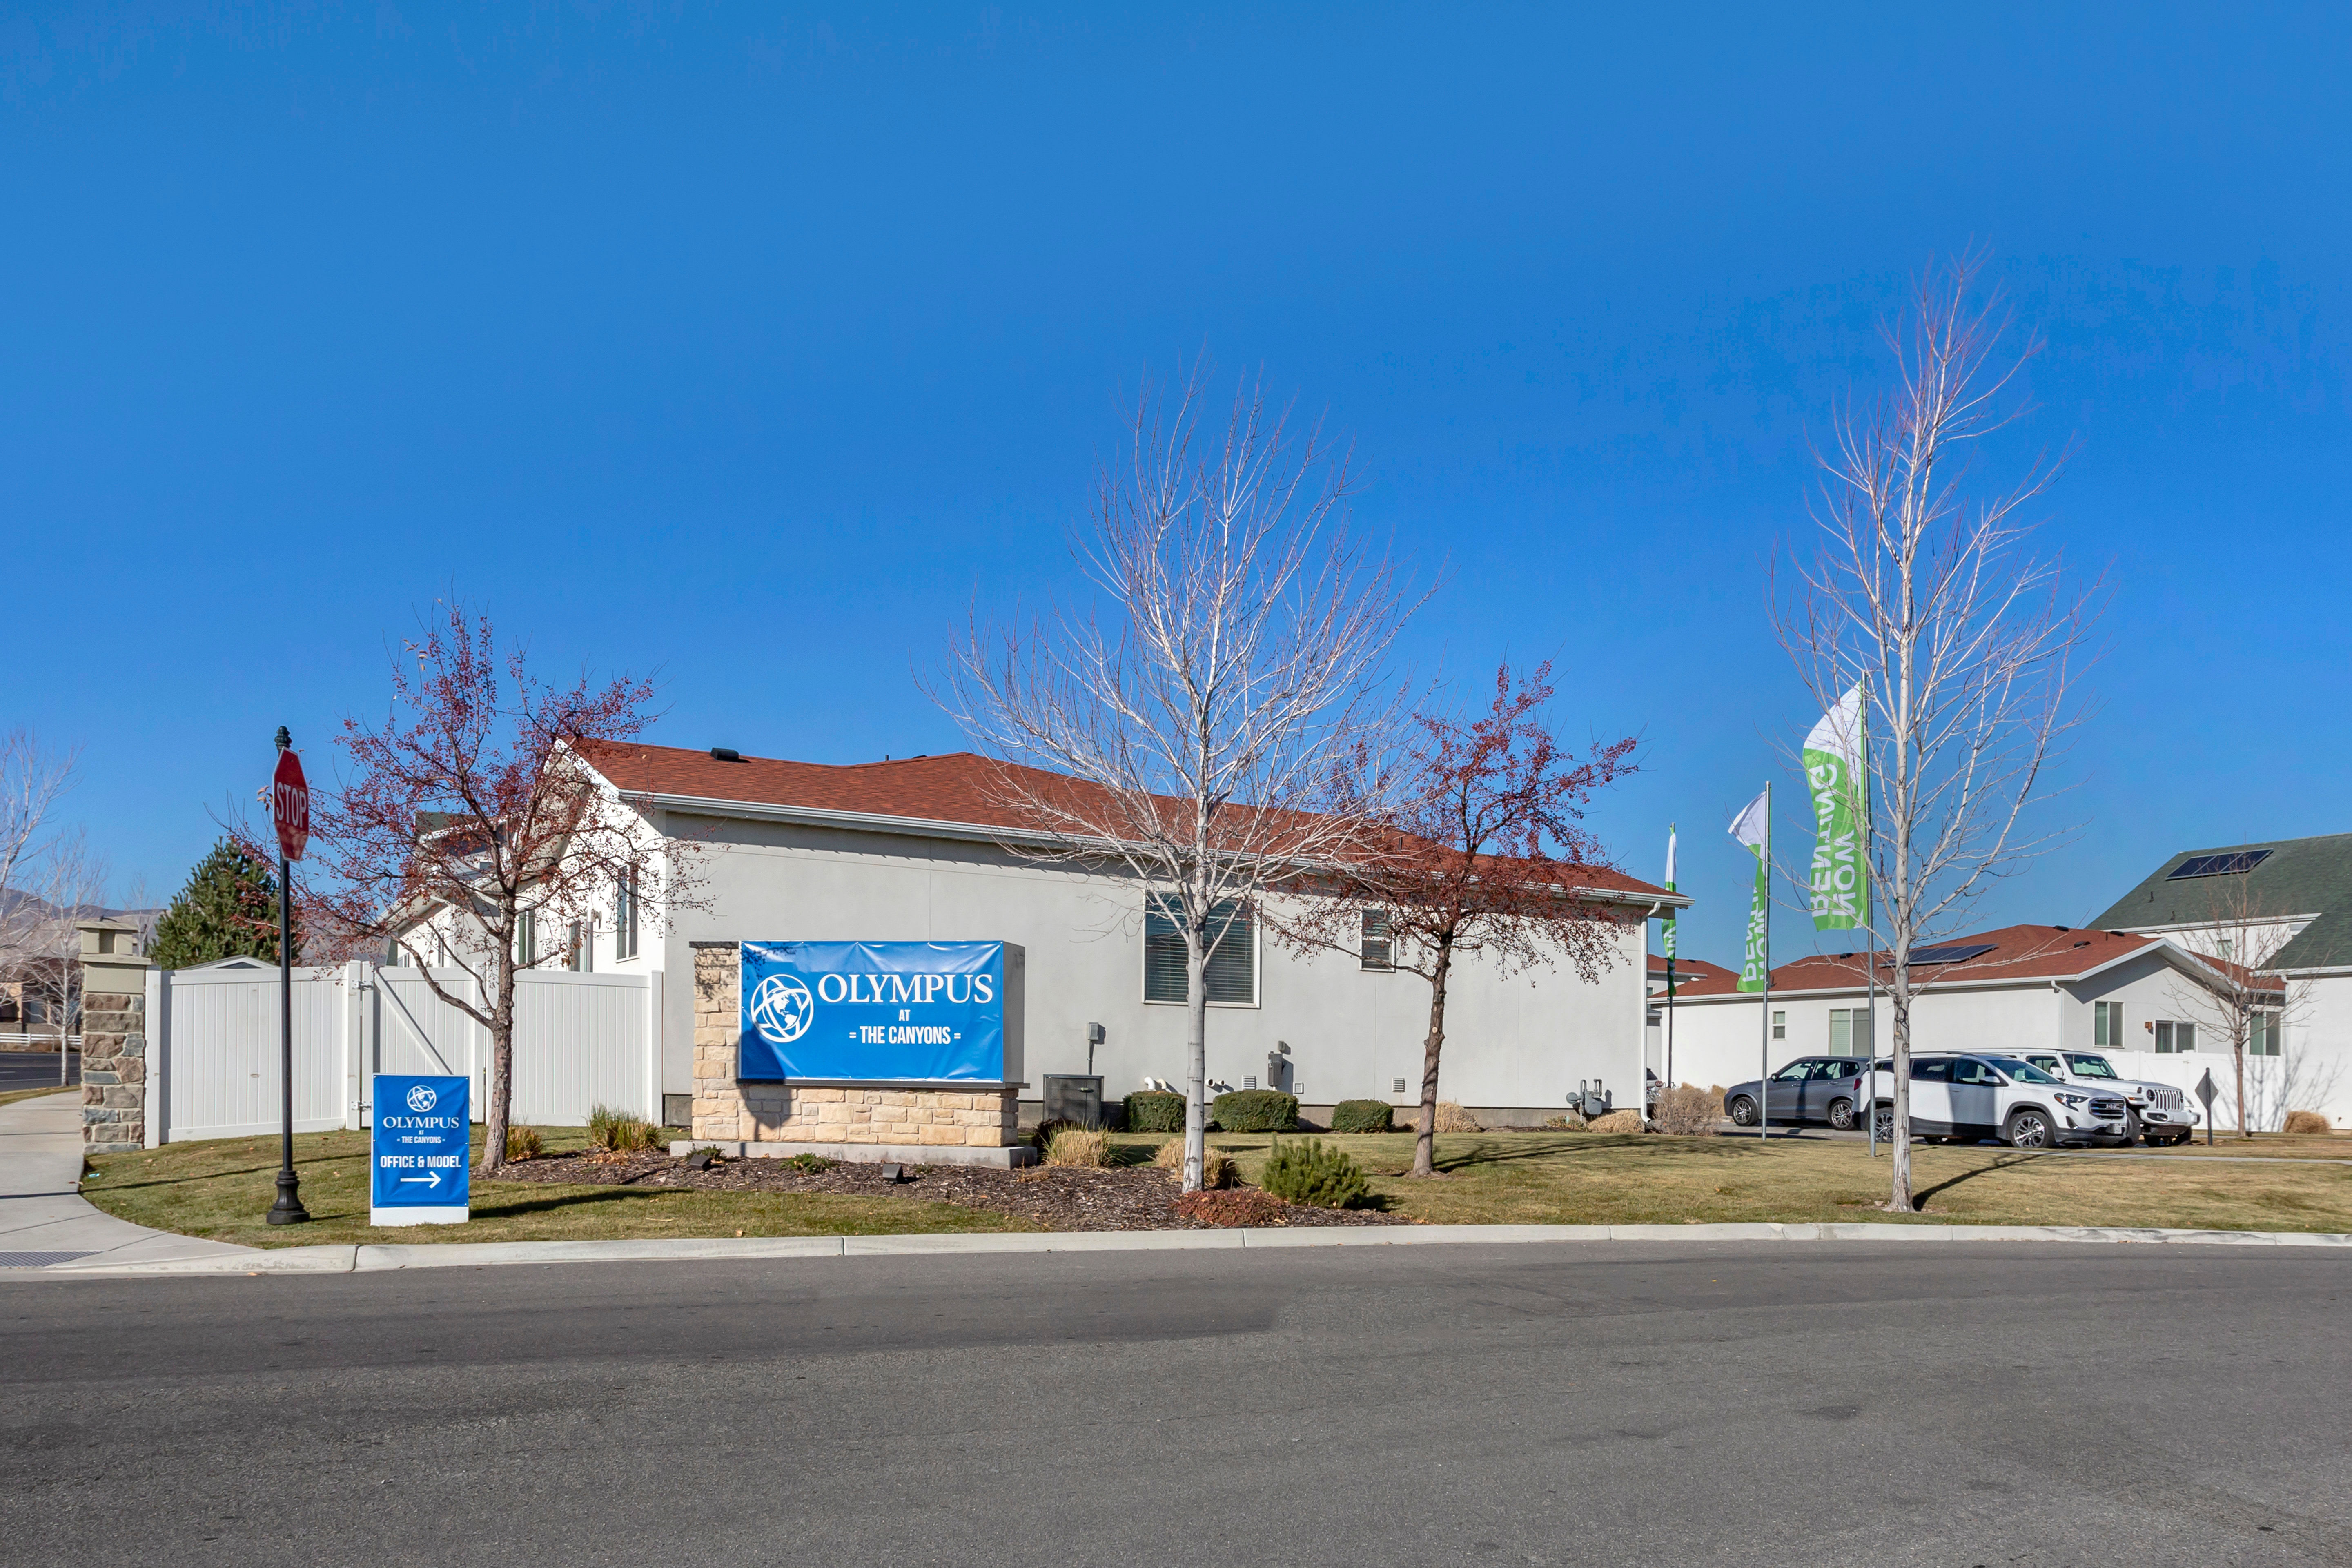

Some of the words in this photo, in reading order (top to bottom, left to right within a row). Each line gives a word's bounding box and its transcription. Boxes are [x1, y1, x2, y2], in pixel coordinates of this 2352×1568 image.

[276, 782, 306, 828] STOP
[818, 974, 993, 1003] OLYMPUS
[899, 1010, 910, 1021] AT
[860, 1026, 885, 1044] THE
[889, 1026, 951, 1045] CANYONS
[383, 1116, 459, 1128] OLYMPUS
[380, 1156, 414, 1168] OFFICE
[418, 1156, 425, 1168] &
[427, 1156, 461, 1167] MODEL
